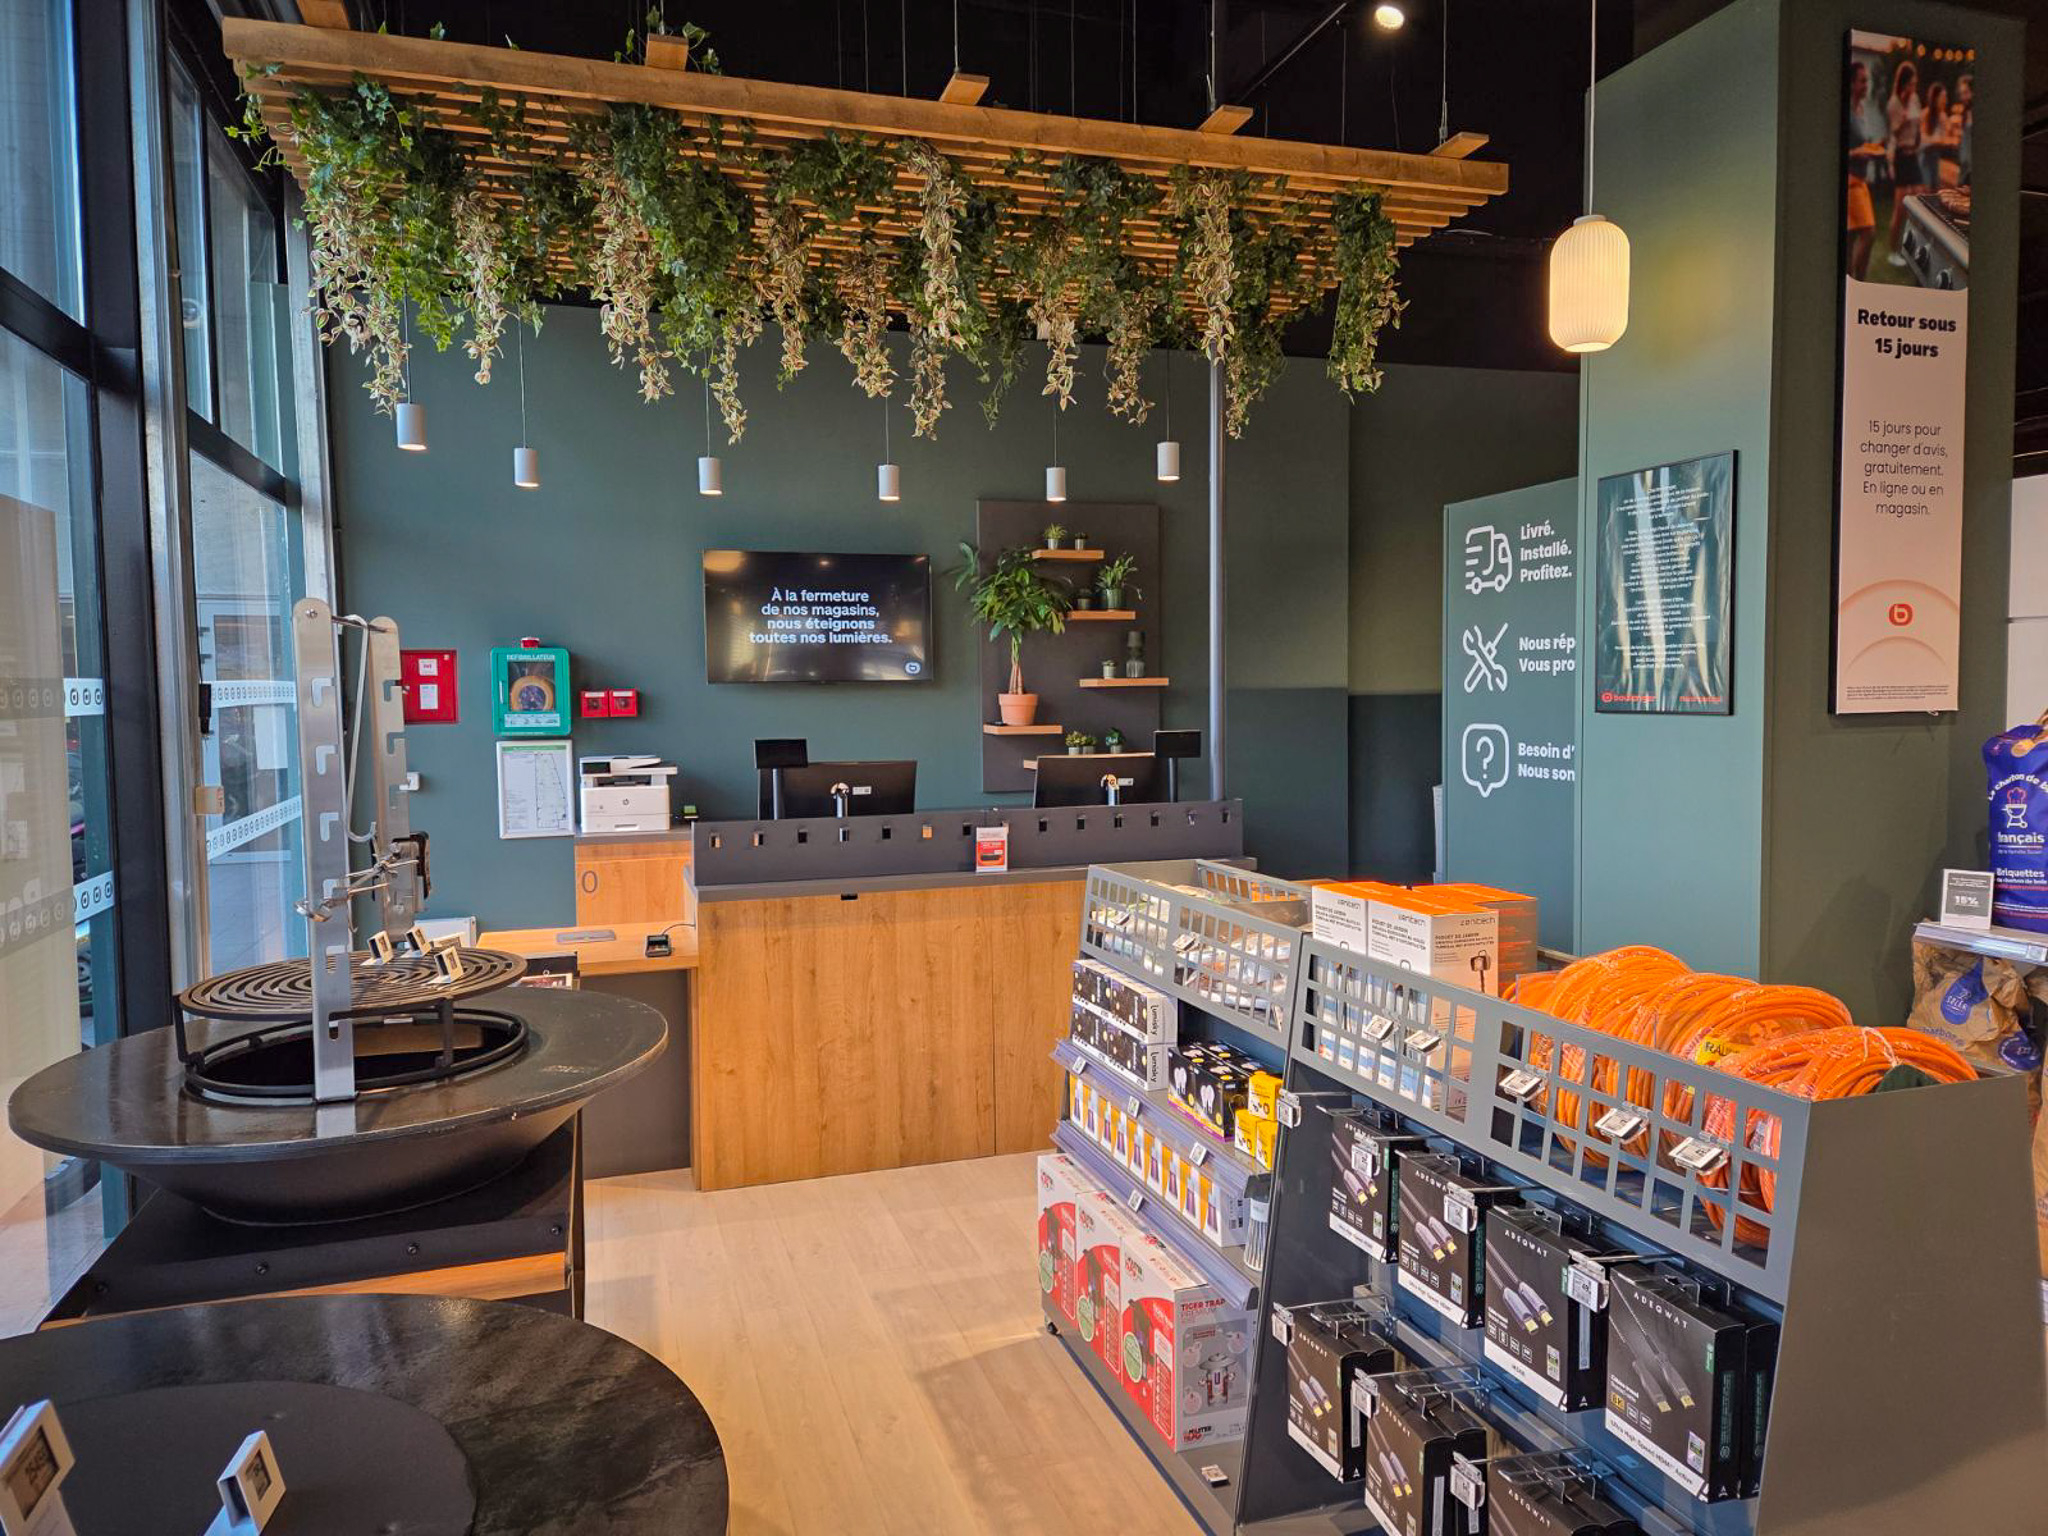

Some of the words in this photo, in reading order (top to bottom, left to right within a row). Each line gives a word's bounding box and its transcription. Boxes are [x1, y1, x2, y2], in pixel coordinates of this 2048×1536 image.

[1857, 308, 1915, 329] Retour
[1918, 317, 1957, 333] sous
[1874, 337, 1893, 354] 15
[1894, 338, 1940, 359] jours
[1868, 420, 1880, 433] 15
[1882, 421, 1912, 438] jours
[1914, 425, 1942, 438] pour
[1860, 441, 1911, 458] changer
[1864, 461, 1944, 477] gratuitement.
[1863, 481, 1877, 494] En
[1879, 482, 1908, 498] ligne
[1911, 485, 1926, 496] ou
[1928, 486, 1944, 497] en
[1876, 503, 1930, 518] magasin.
[1520, 521, 1555, 541] Livré.
[1520, 540, 1573, 562] Installé.
[1520, 561, 1573, 583] Profitez.
[771, 587, 782, 601] À
[785, 590, 798, 601] la
[800, 590, 869, 602] fermeture
[761, 604, 779, 615] de
[783, 605, 808, 615] nos
[812, 604, 879, 618] magasins,
[767, 619, 801, 630] nous
[805, 617, 875, 632] éteignons
[749, 631, 797, 643] toutes
[800, 633, 826, 643] nos
[829, 631, 893, 643] lumières.
[1519, 636, 1551, 652] Nous
[1519, 657, 1551, 673] Vous
[1517, 742, 1560, 759] Besoin
[1517, 763, 1550, 780] Nous
[1633, 1291, 1688, 1330] ADEQWAT
